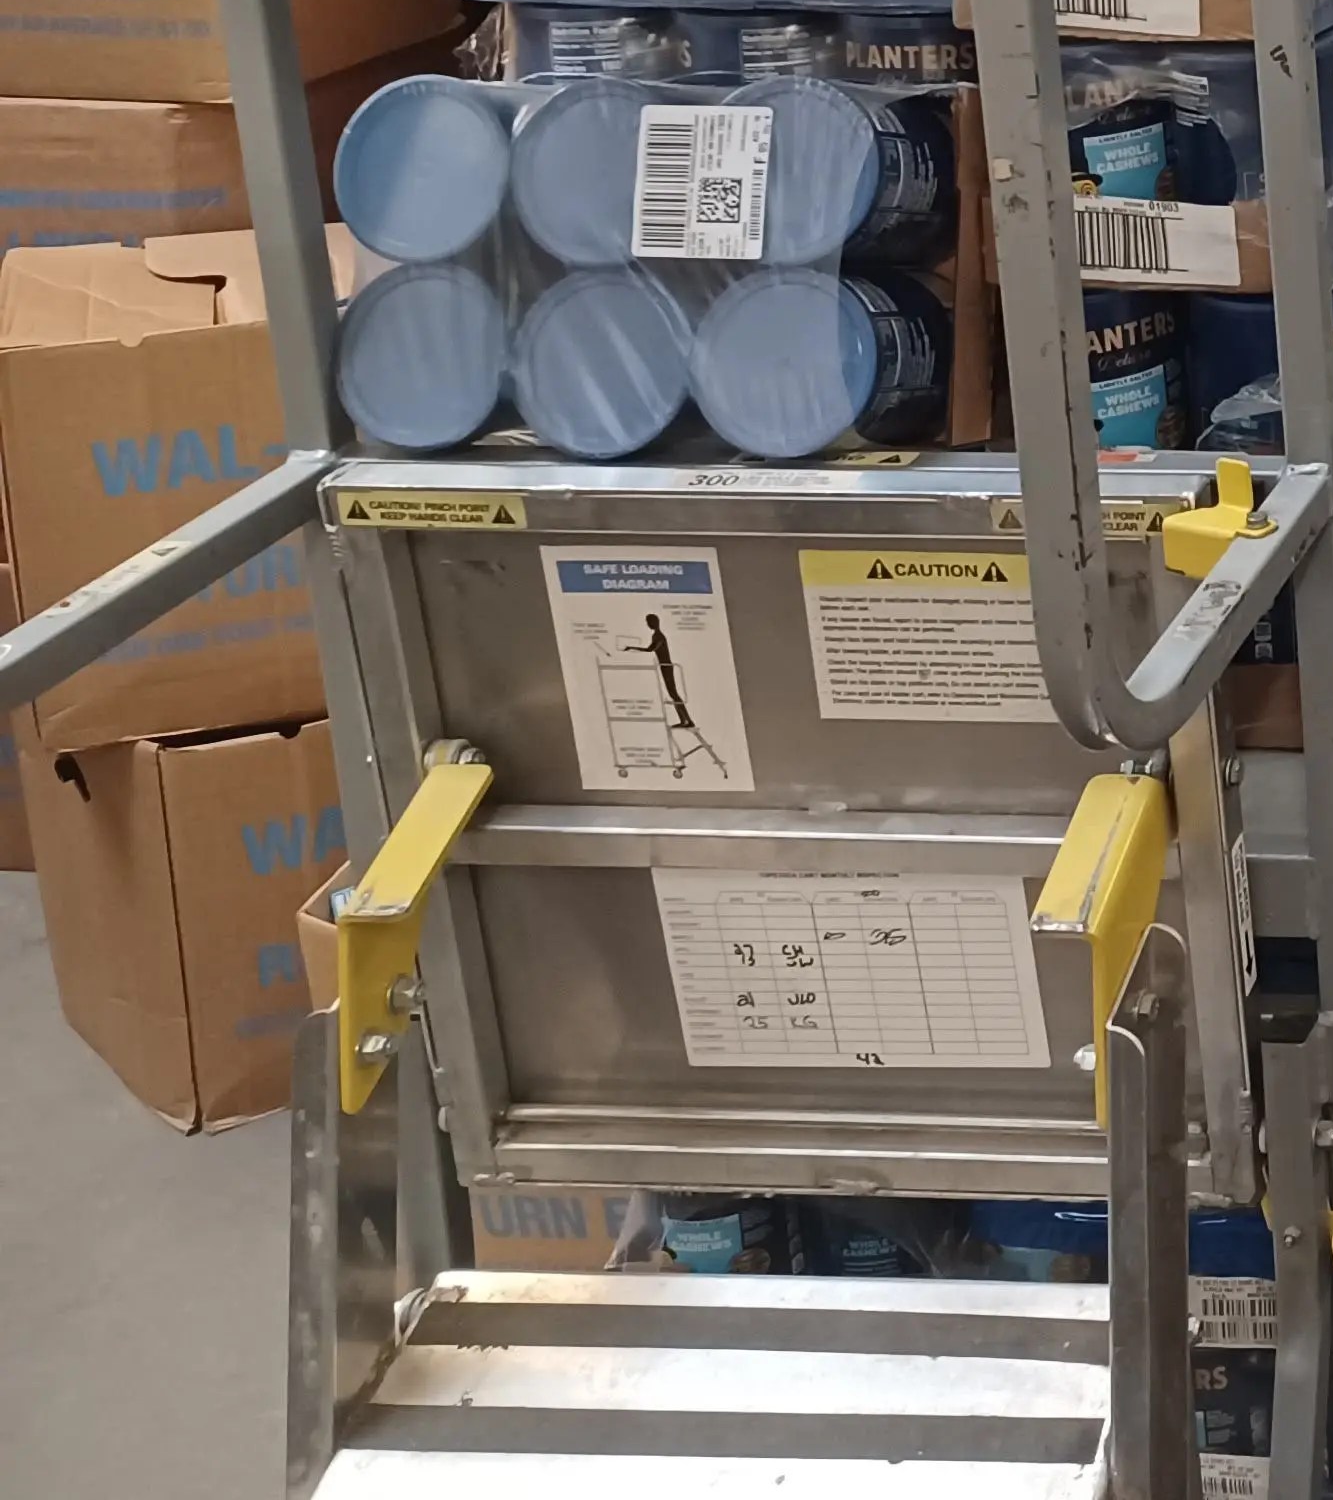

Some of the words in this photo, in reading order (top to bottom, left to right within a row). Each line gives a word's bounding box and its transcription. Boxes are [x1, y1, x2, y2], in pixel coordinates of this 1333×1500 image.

[846, 42, 974, 71] PLANTERS
[1103, 142, 1152, 161] WHOLE
[1096, 154, 1159, 175] CASHEWS
[1148, 201, 1179, 212] 01903
[1104, 384, 1153, 407] WHOLE
[1096, 396, 1160, 419] CASHEWS
[689, 474, 739, 487] 300
[449, 514, 484, 523] CLEAR
[1113, 510, 1146, 521] POINT
[583, 563, 618, 574] SAFE
[621, 564, 683, 576] LOADING
[894, 563, 978, 578] CAUTION
[602, 578, 669, 590] DIAGRAM
